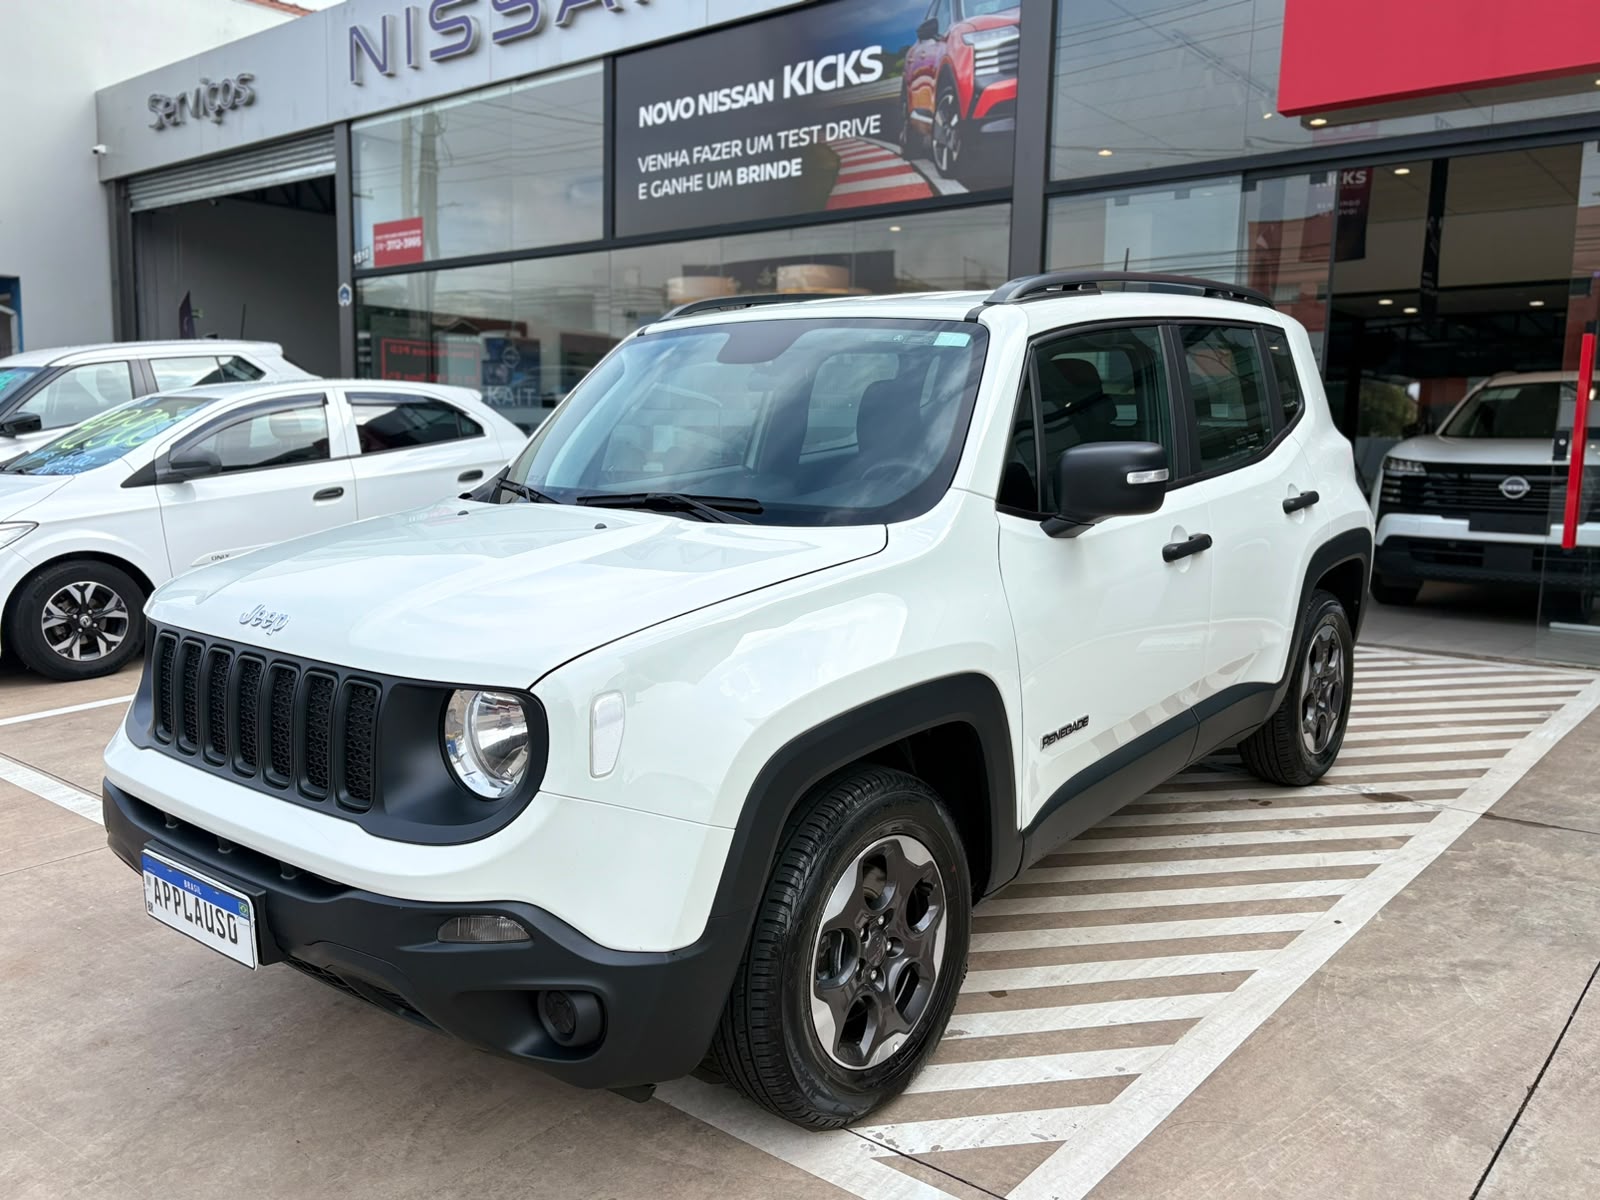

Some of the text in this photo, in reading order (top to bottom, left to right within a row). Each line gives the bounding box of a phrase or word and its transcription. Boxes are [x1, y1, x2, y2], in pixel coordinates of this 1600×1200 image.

[147, 72, 256, 132] Serviços
[639, 45, 883, 128] NOVO NISSAN KICKS
[637, 114, 882, 173] VENHA FAZER UM TEST DRIVE
[638, 157, 803, 200] E GANHE UM BRINDE
[239, 603, 289, 637] Jeep
[1041, 714, 1089, 750] RENEGADE
[153, 876, 238, 946] APPLAUSO
[183, 878, 202, 896] BRASIL
